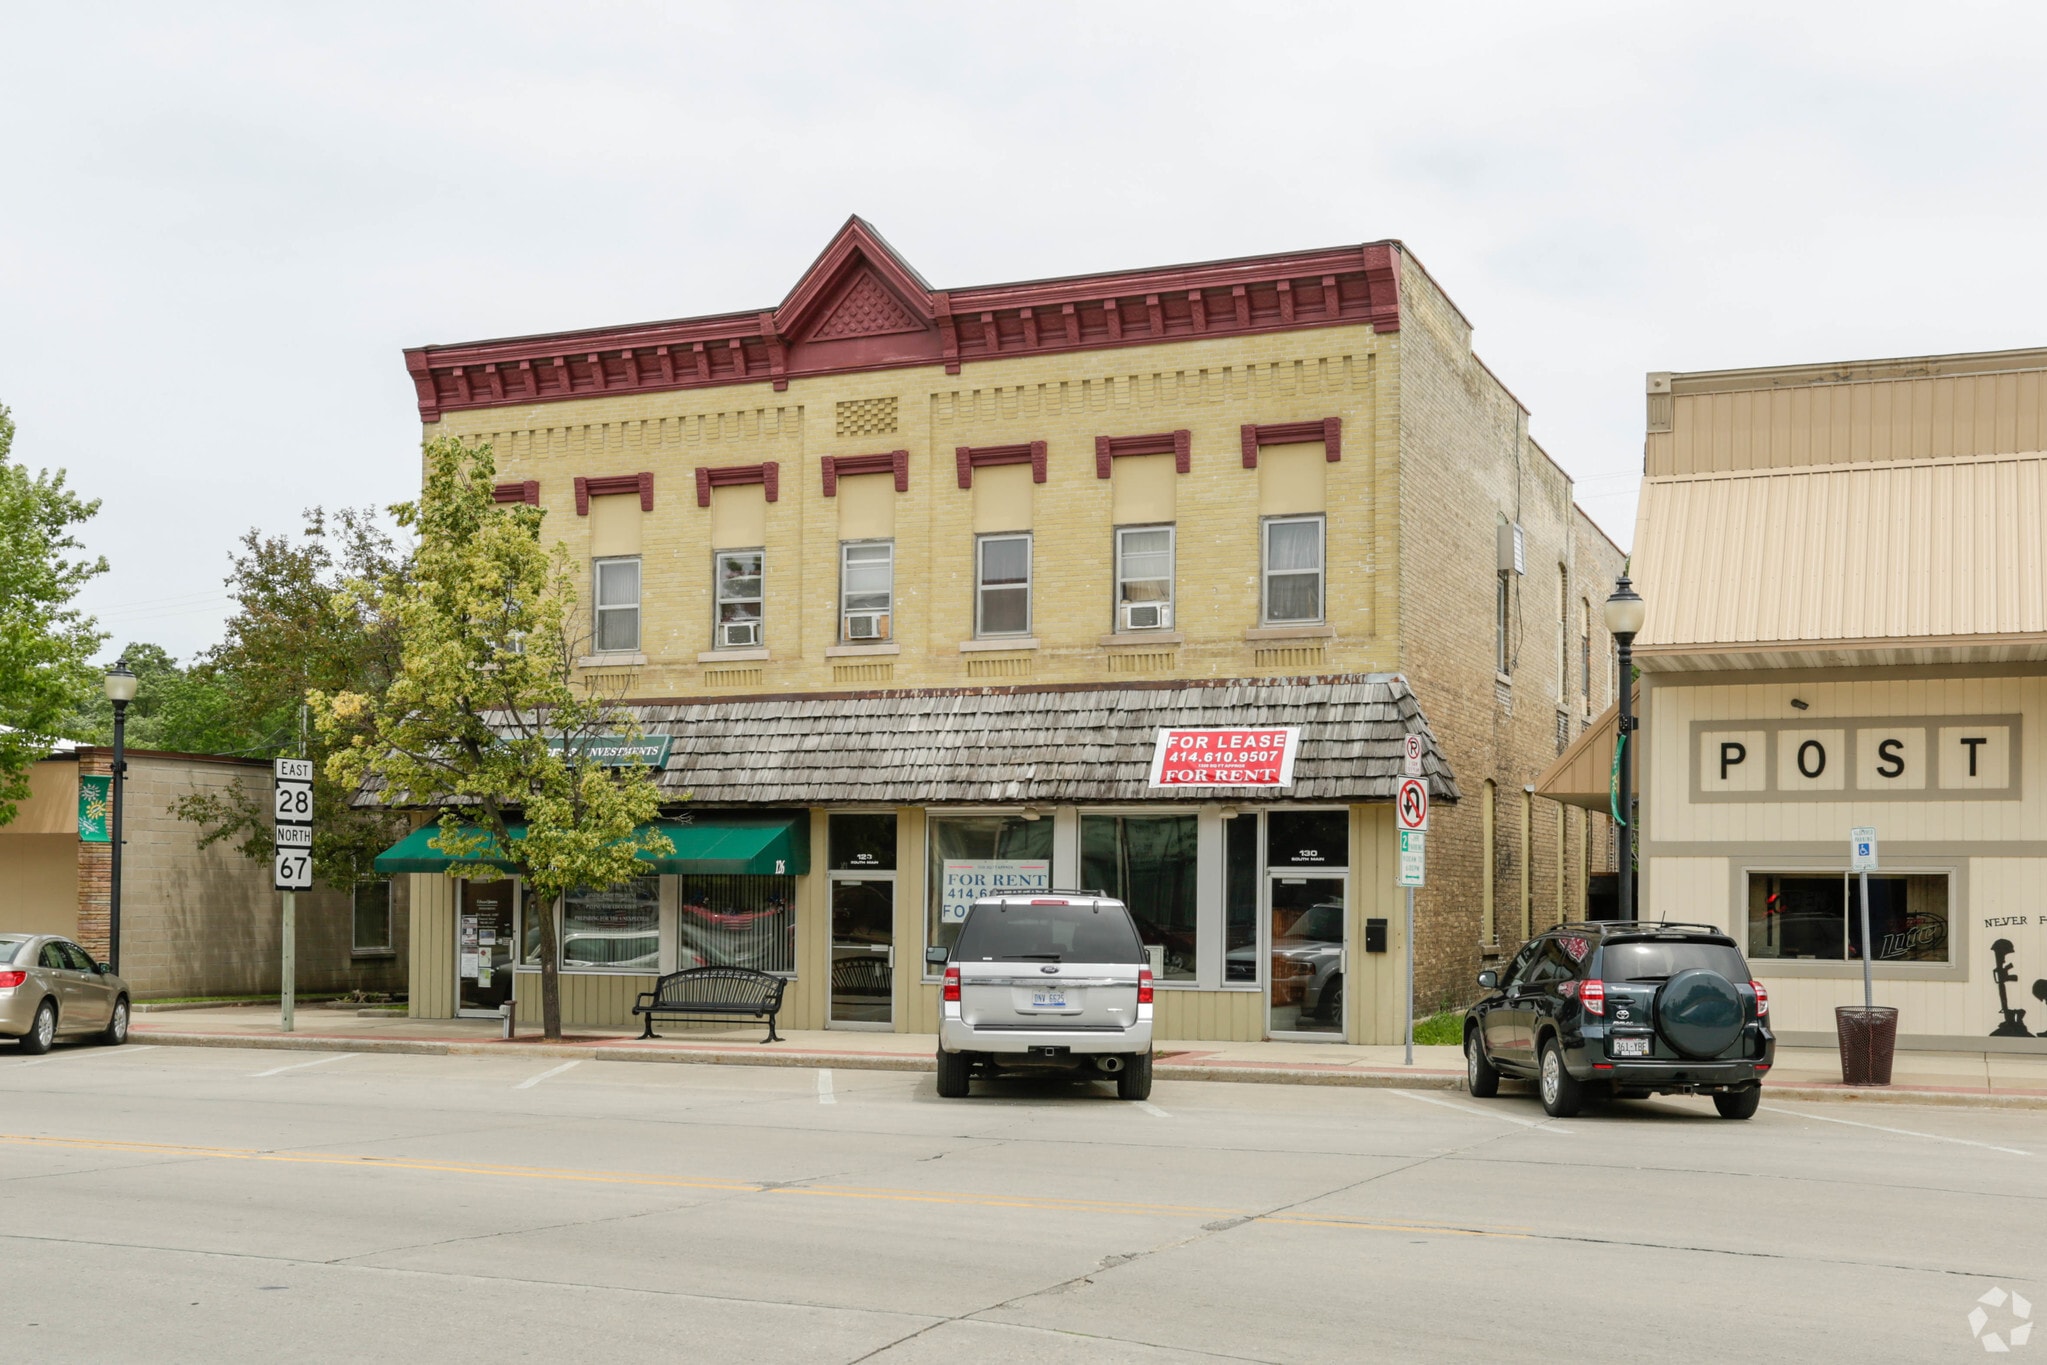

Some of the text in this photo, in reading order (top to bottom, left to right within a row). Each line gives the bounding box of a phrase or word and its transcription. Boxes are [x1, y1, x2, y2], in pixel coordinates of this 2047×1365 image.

[1167, 734, 1286, 749] FOR LEASE
[587, 745, 659, 758] NVESTMENTS
[1168, 750, 1278, 763] 414.610.9507
[1720, 738, 1987, 779] POST
[281, 761, 308, 777] EAST
[1165, 768, 1276, 782] FOR RENT
[279, 790, 308, 814] 28
[278, 828, 310, 842] NORTH
[1402, 834, 1408, 849] 2
[280, 857, 307, 880] 67
[948, 874, 1047, 886] FOR RENT
[943, 905, 973, 918] FO
[1984, 916, 2028, 928] NEVER
